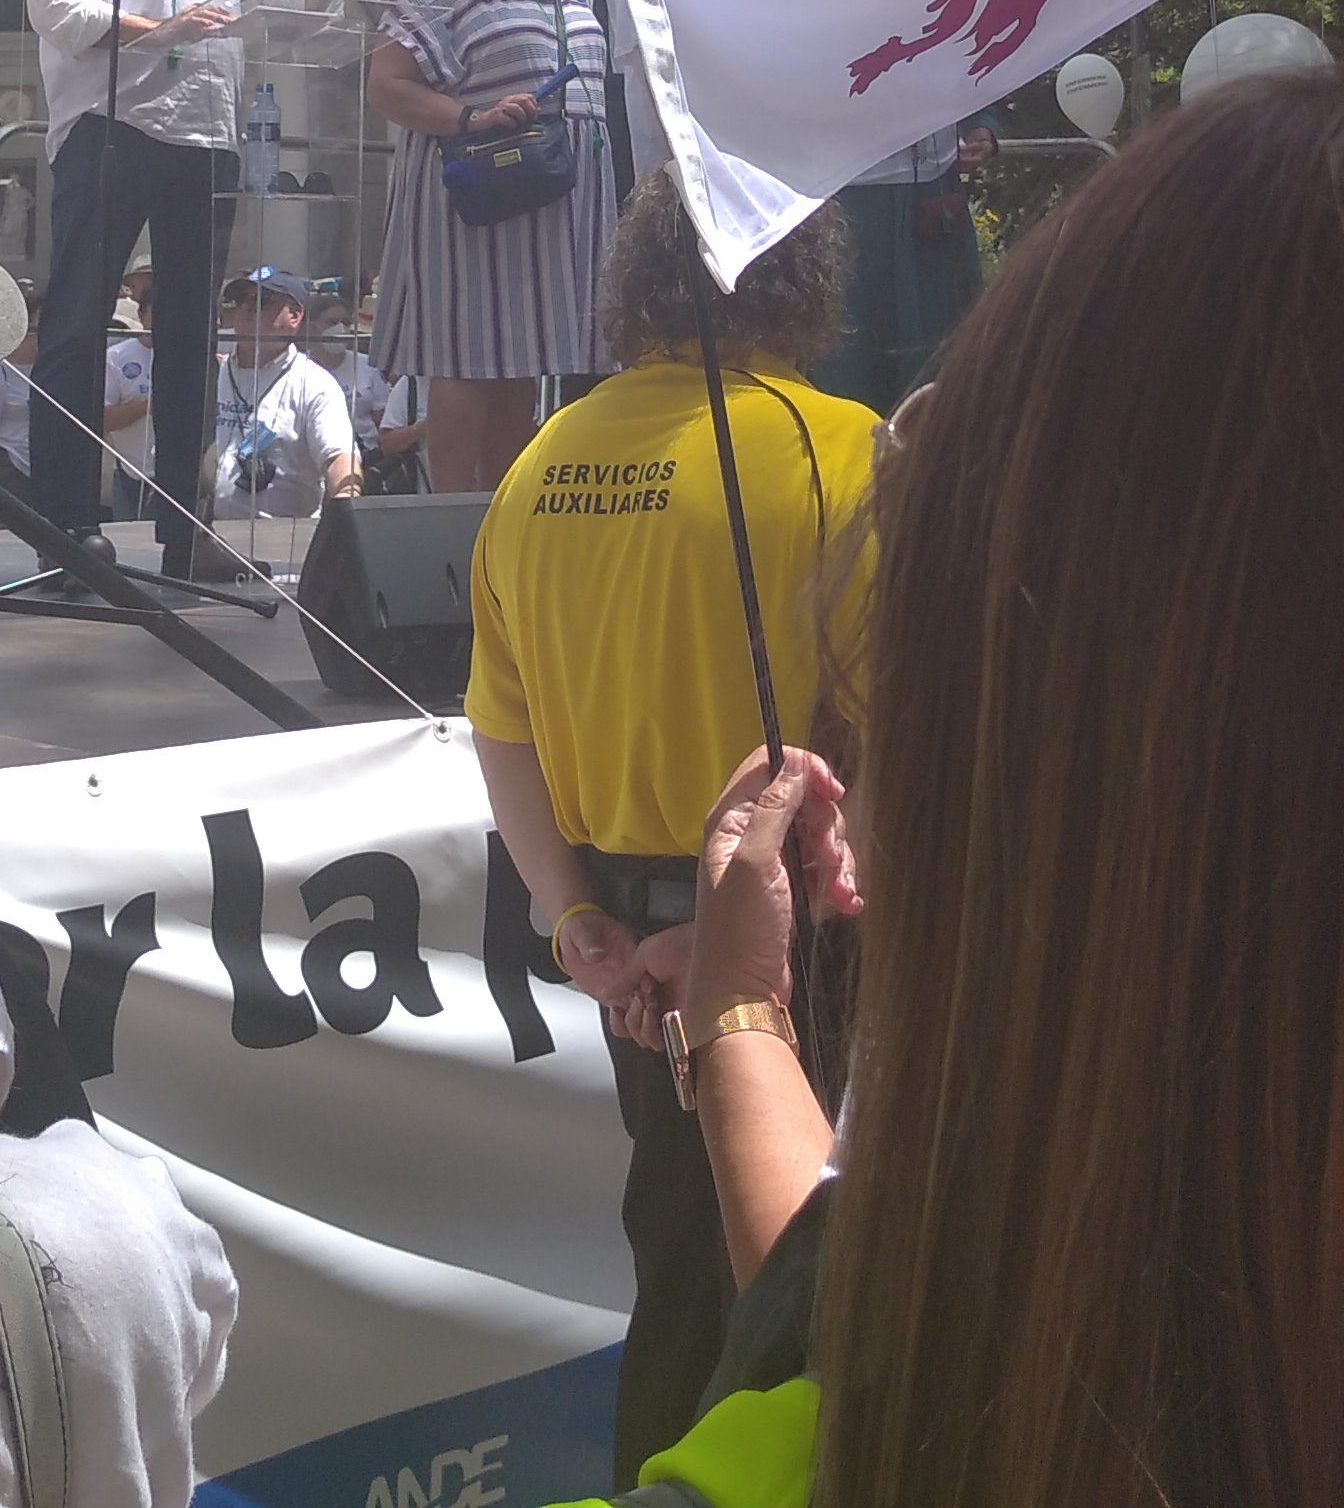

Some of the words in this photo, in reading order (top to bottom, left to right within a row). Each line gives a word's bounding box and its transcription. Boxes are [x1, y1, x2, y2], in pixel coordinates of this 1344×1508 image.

[542, 460, 678, 487] SERVICIOS
[532, 488, 671, 516] AUXILIARES
[200, 807, 445, 1050] la
